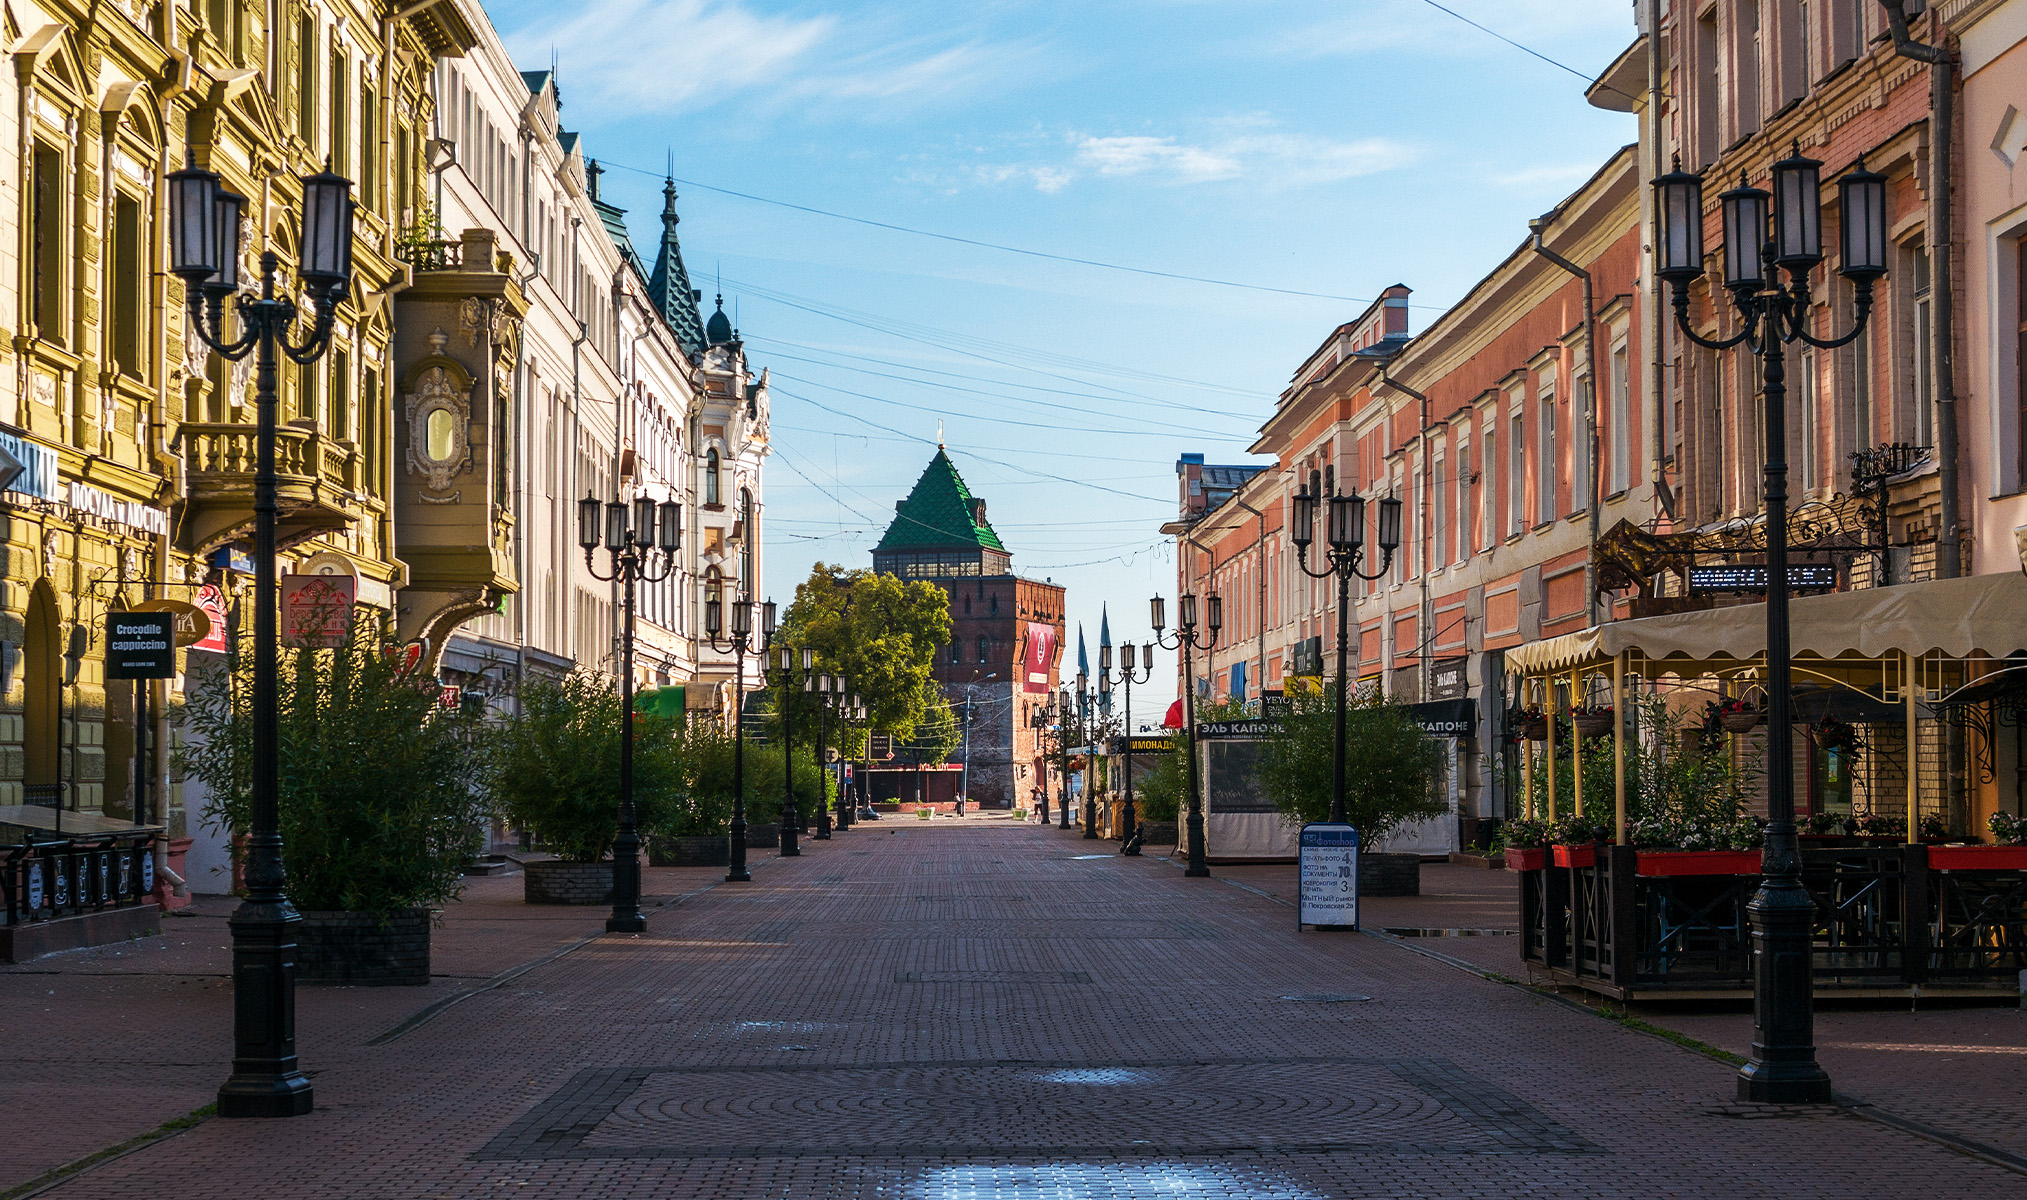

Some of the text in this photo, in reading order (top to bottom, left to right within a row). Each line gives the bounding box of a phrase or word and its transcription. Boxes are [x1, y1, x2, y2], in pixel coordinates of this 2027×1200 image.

[71, 481, 116, 521] ПОСУДА
[127, 501, 167, 536] ЛЮСТРЫ
[116, 624, 162, 635] Crocodile
[112, 640, 167, 651] cappuccino
[1201, 723, 1228, 733] ЭЛЬ
[1340, 880, 1348, 892] 3
